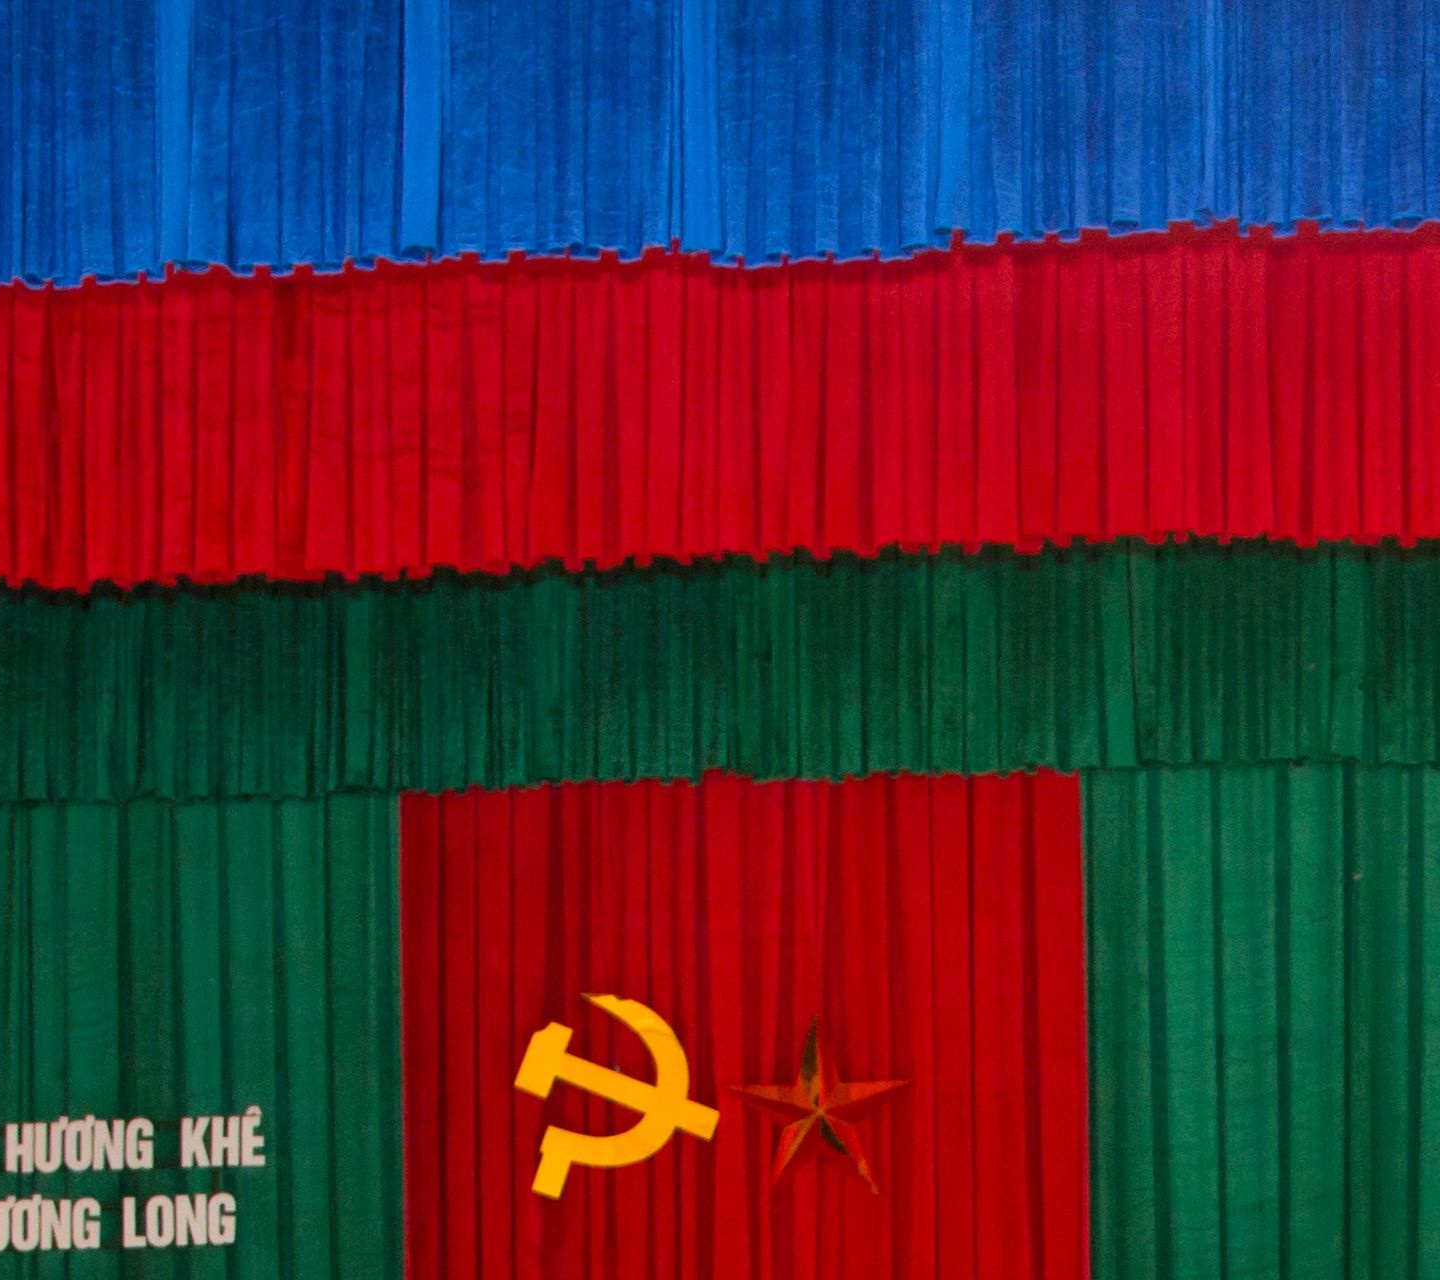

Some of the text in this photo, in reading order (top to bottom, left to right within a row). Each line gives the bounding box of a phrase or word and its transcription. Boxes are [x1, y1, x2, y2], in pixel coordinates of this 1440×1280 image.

[5, 1114, 154, 1174] HƯƠNG
[180, 1105, 266, 1168] KHÊ
[122, 1192, 237, 1247] LONG
